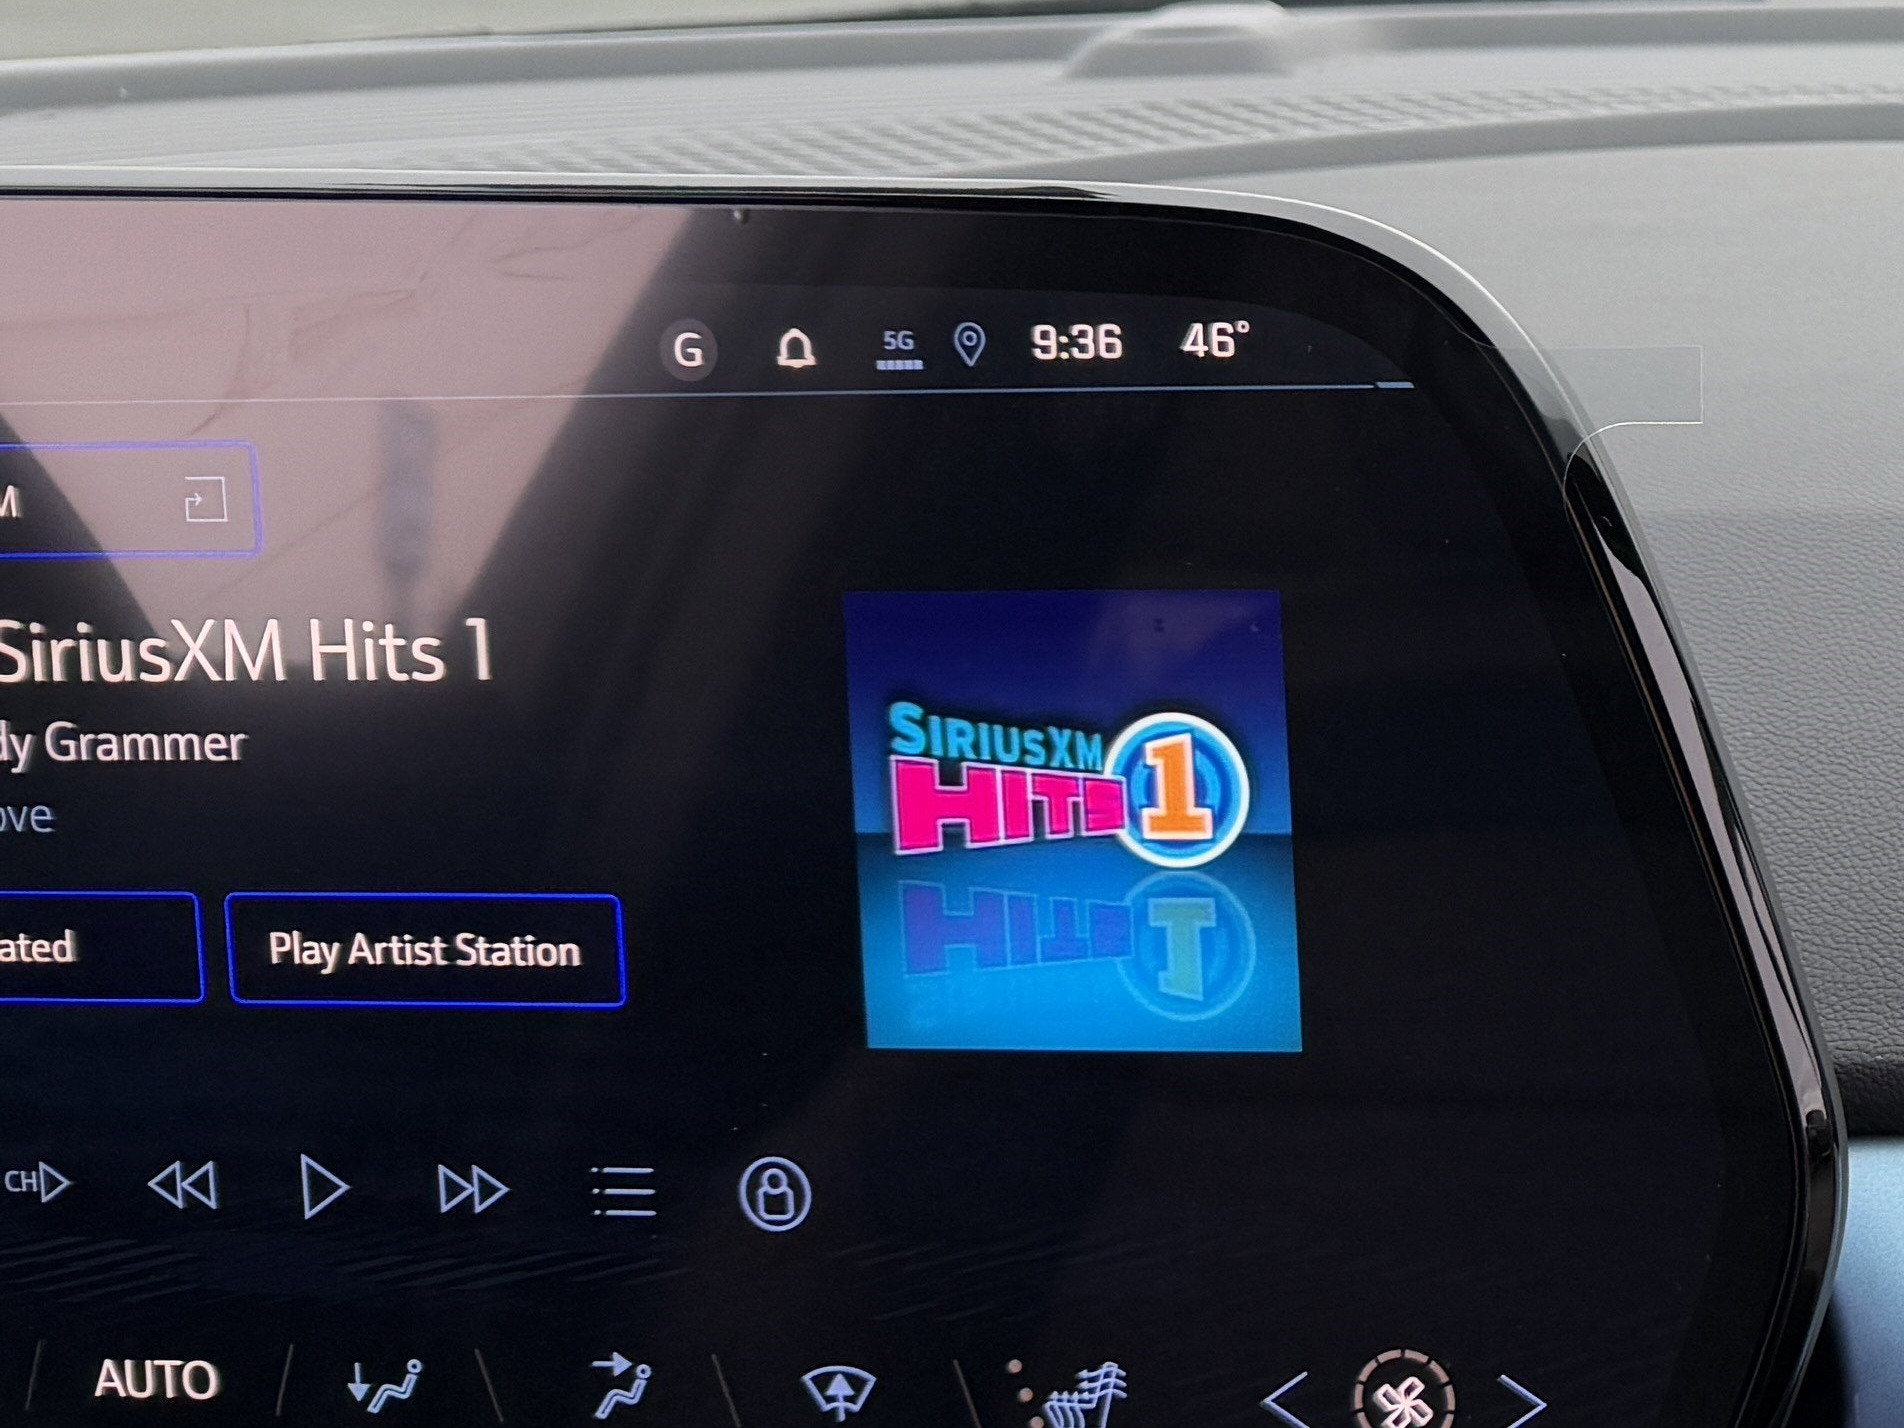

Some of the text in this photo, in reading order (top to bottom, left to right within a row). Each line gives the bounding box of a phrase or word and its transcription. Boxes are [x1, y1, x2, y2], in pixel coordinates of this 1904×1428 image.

[673, 332, 704, 368] G
[883, 330, 915, 352] 5G
[1031, 323, 1125, 362] 9:36
[0, 616, 494, 684] SiriusXM Hits 1
[45, 720, 249, 762] Grammer
[889, 730, 1214, 856] HITS 1
[269, 929, 583, 975] Play Artist Station
[4, 1169, 38, 1194] CH
[93, 1357, 220, 1402] AUTO
